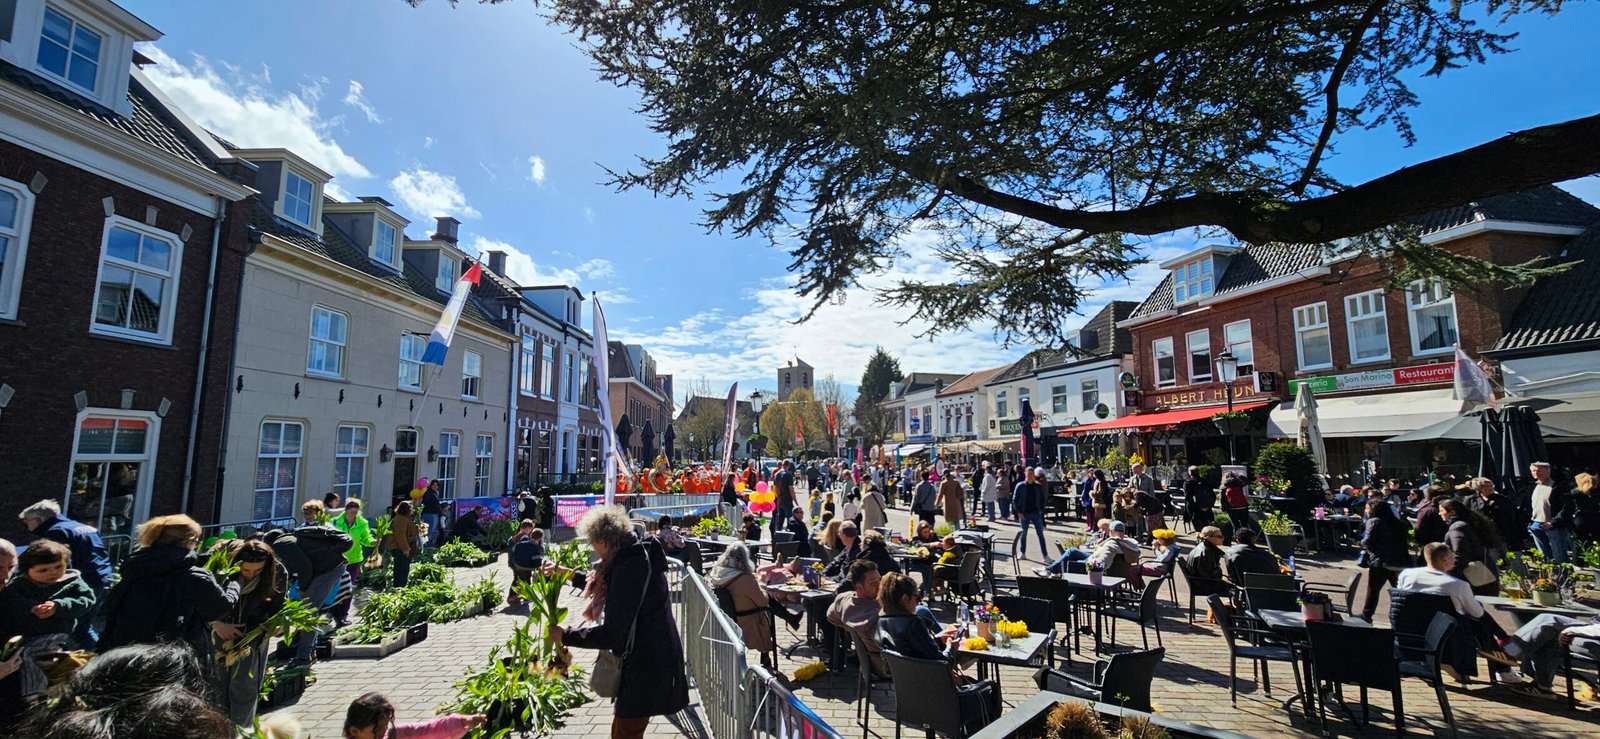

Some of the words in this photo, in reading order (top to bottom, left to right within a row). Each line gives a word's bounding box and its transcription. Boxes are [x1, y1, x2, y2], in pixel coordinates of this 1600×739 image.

[1343, 375, 1359, 384] San
[1361, 372, 1393, 381] Marino
[1399, 367, 1454, 379] Restaurant
[1156, 391, 1205, 405] ALBERT
